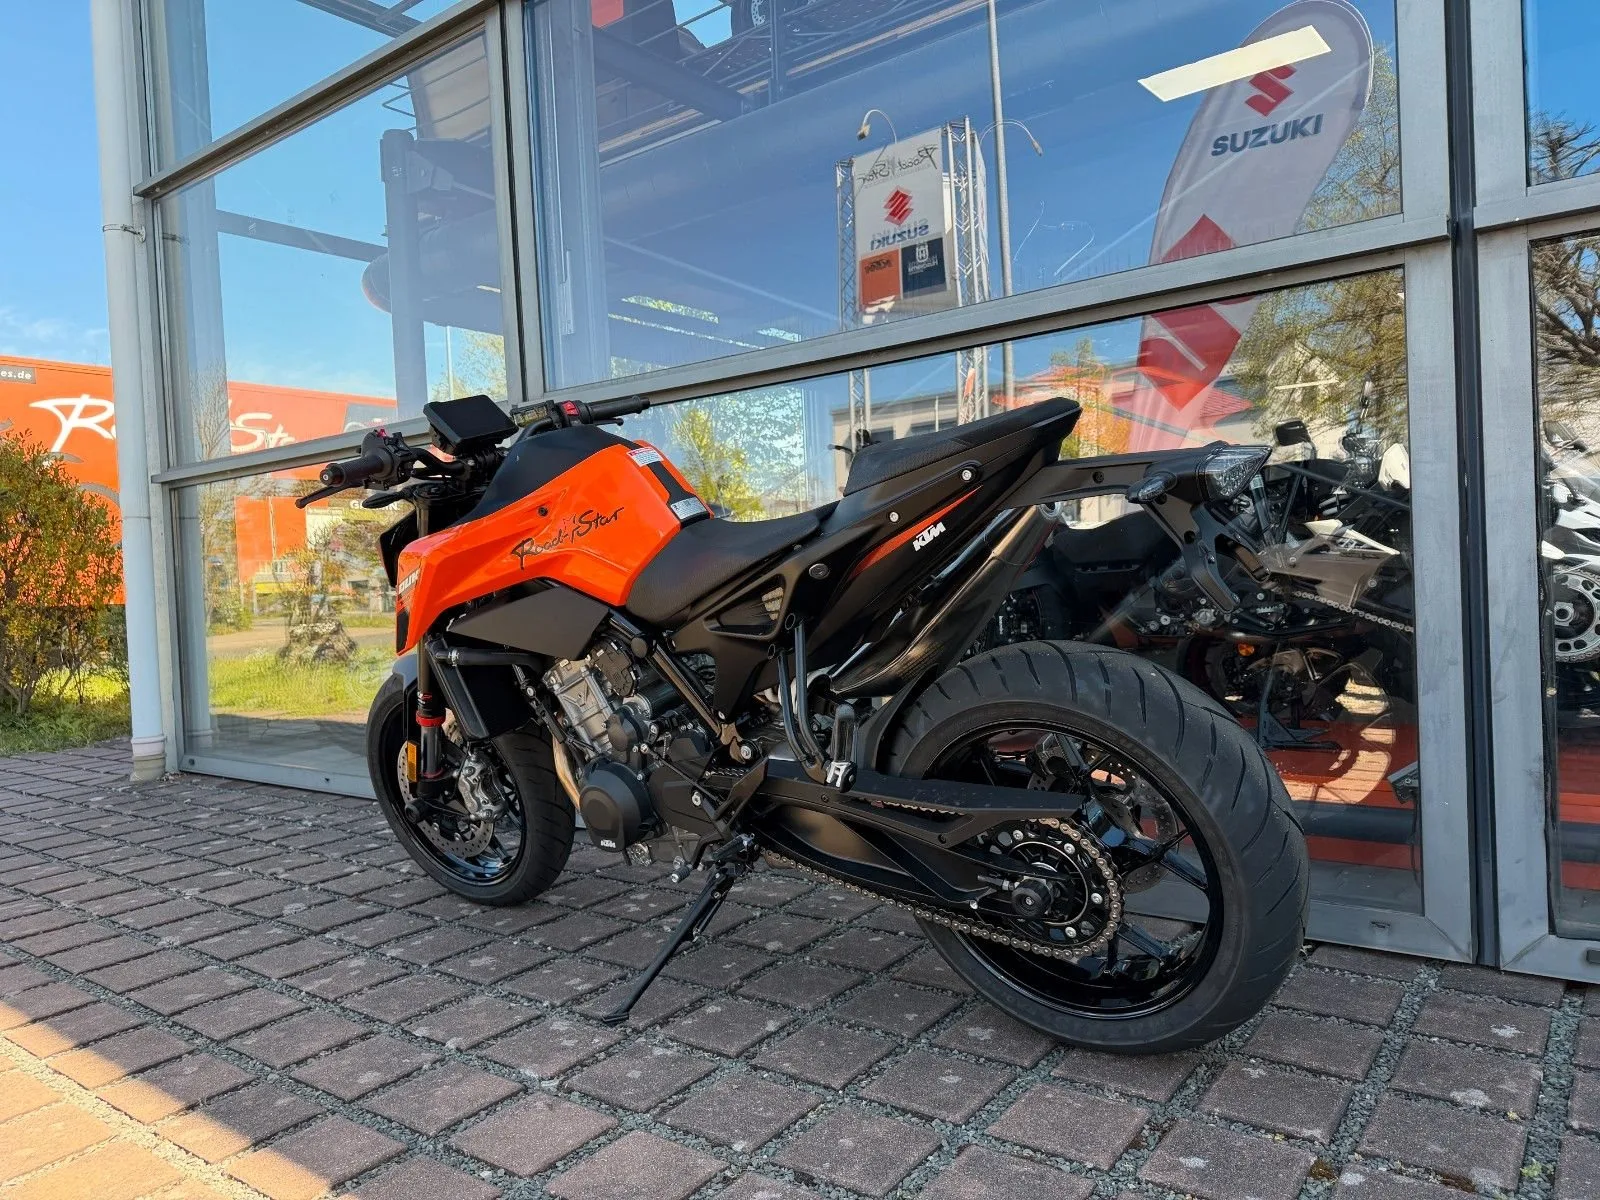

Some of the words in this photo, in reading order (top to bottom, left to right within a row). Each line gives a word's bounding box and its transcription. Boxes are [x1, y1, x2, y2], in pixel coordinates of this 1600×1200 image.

[1210, 113, 1324, 157] SUZUKI
[511, 529, 563, 570] Road
[576, 507, 625, 537] Star
[912, 521, 947, 552] KTM
[600, 839, 617, 849] KTM
